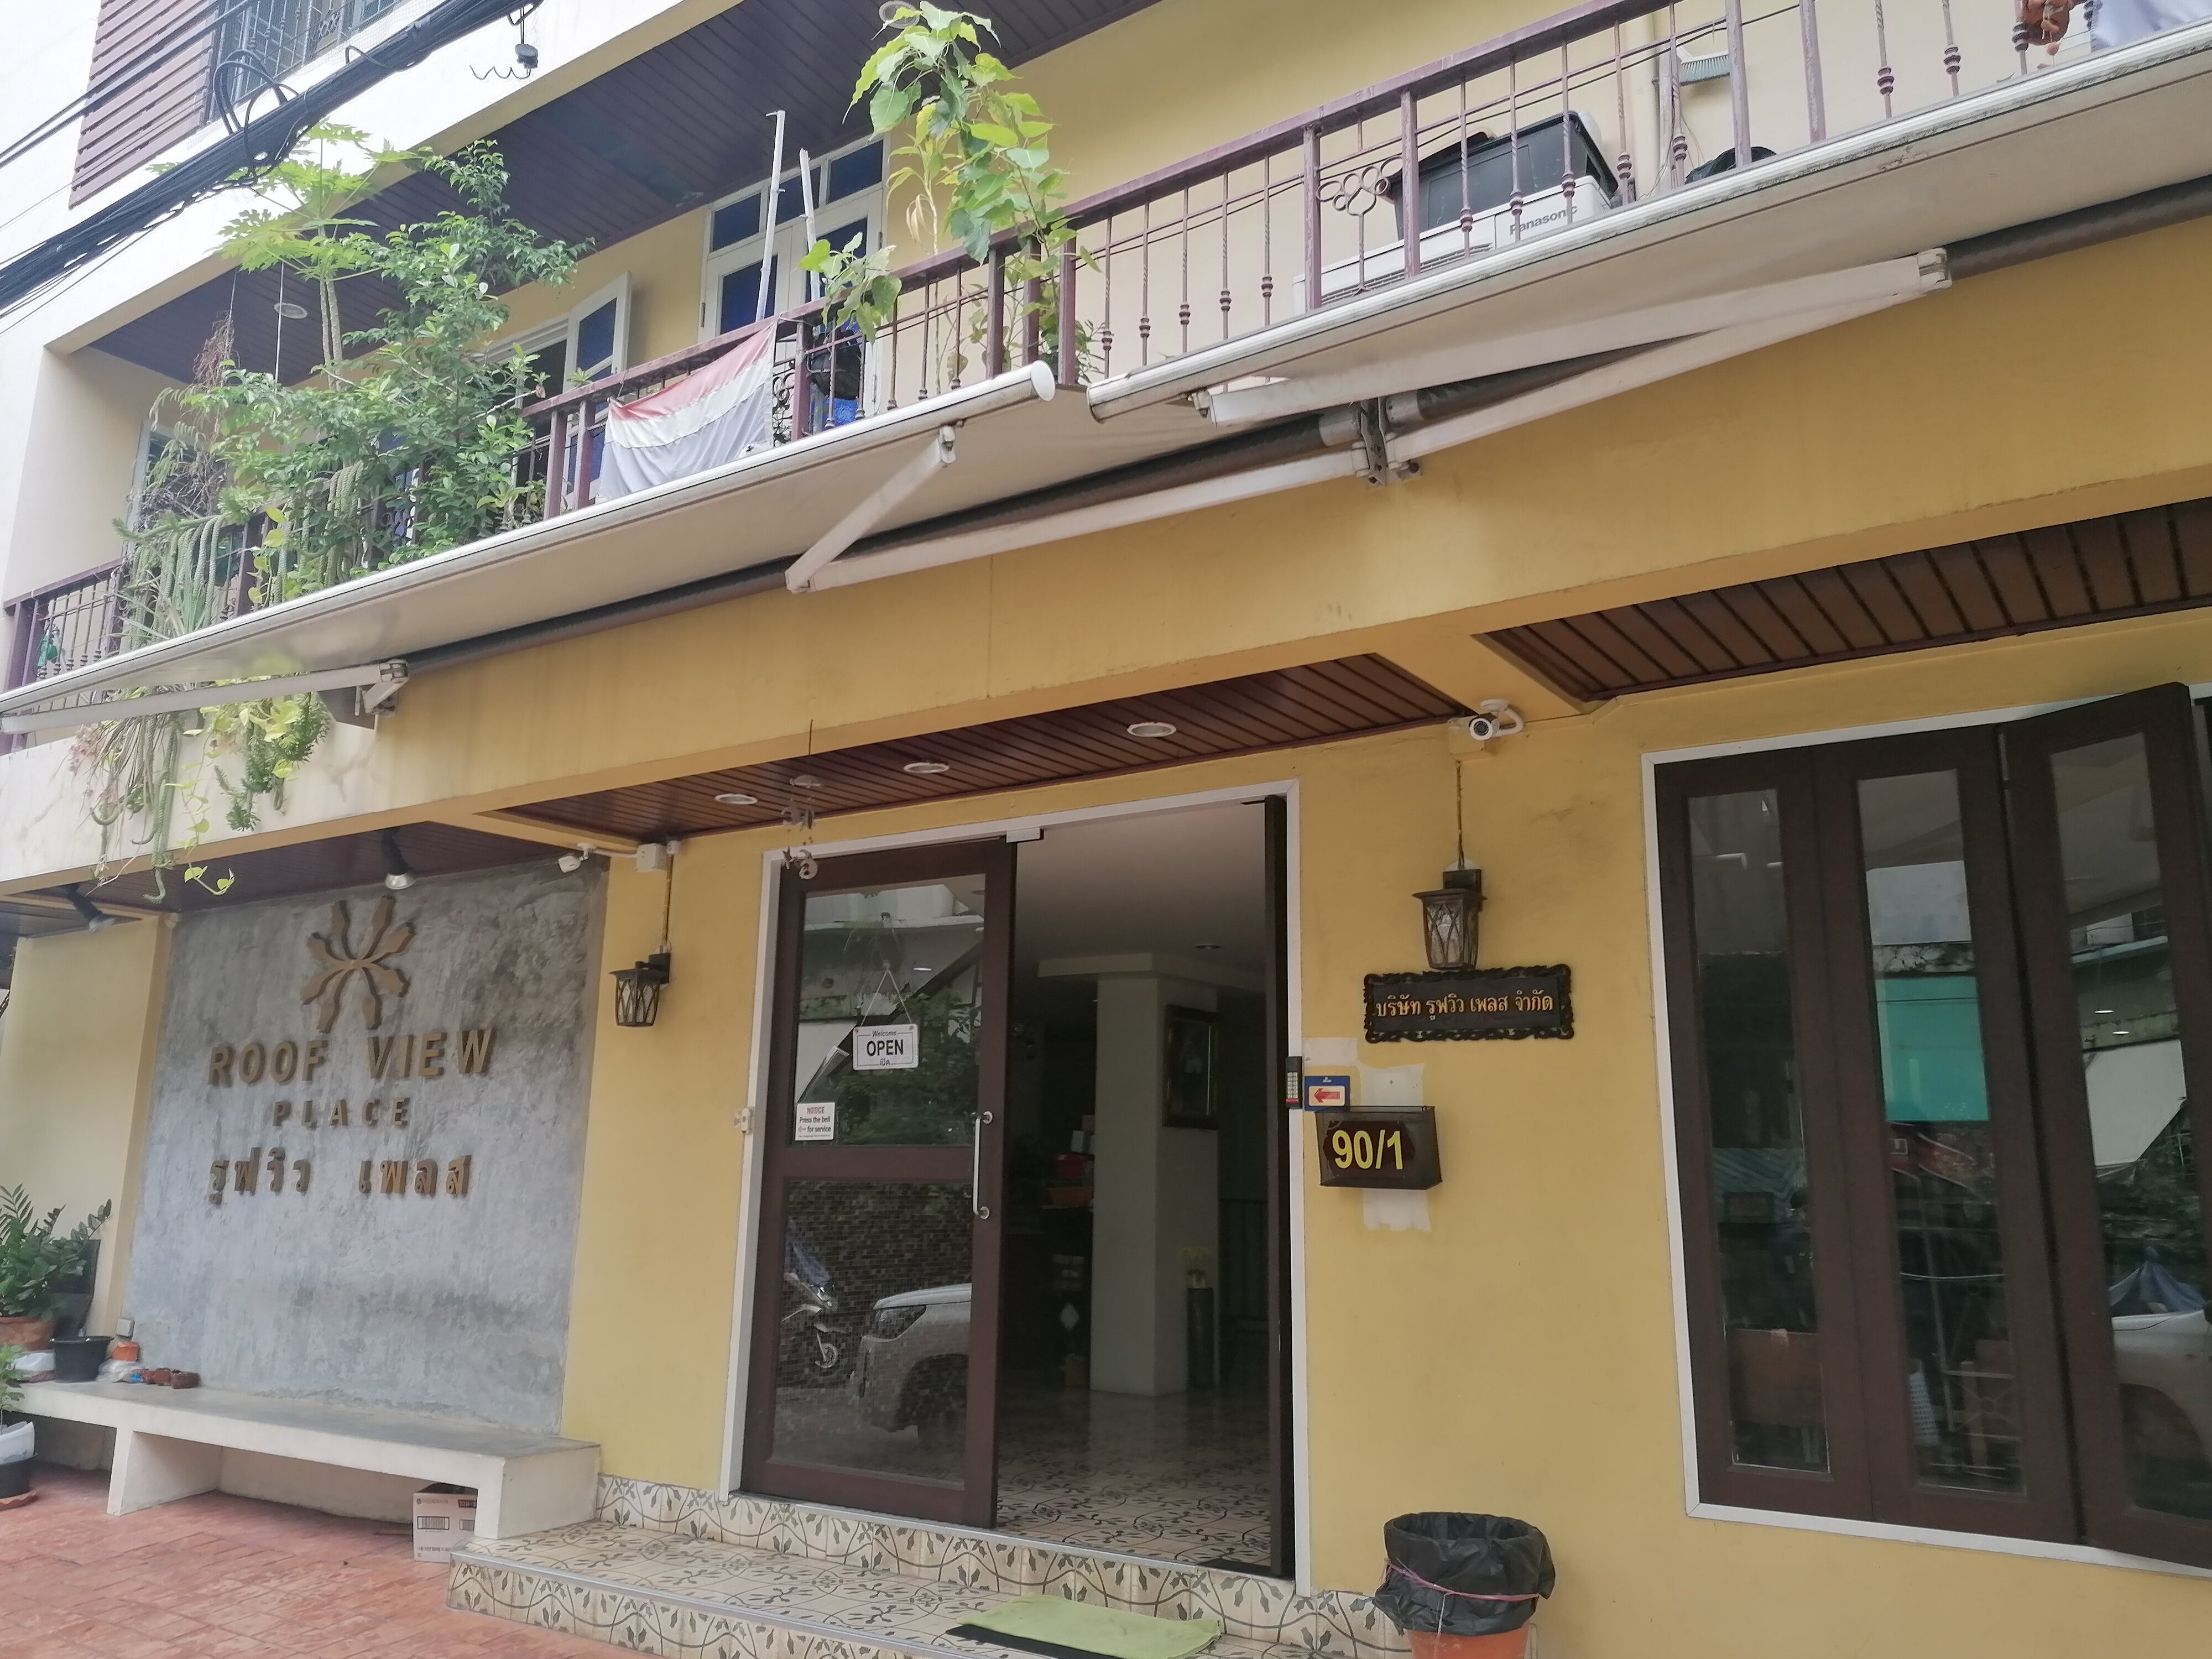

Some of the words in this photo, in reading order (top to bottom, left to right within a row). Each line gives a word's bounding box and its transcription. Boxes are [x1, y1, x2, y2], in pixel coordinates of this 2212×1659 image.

[1510, 206, 1578, 236] Panasonc
[1375, 994, 1422, 1017] บริษัท
[1426, 993, 1464, 1021] รูฟวิว
[1470, 995, 1509, 1013] เพลส
[1515, 989, 1553, 1012] จำกัด
[208, 1039, 328, 1087] ROOF
[367, 1027, 497, 1080] VIEW
[866, 1039, 904, 1057] OPEN
[272, 1097, 411, 1128] PLACE
[1332, 1129, 1404, 1171] 90/1
[208, 1146, 312, 1206] รูฟวิว
[358, 1155, 472, 1197] เพลส
